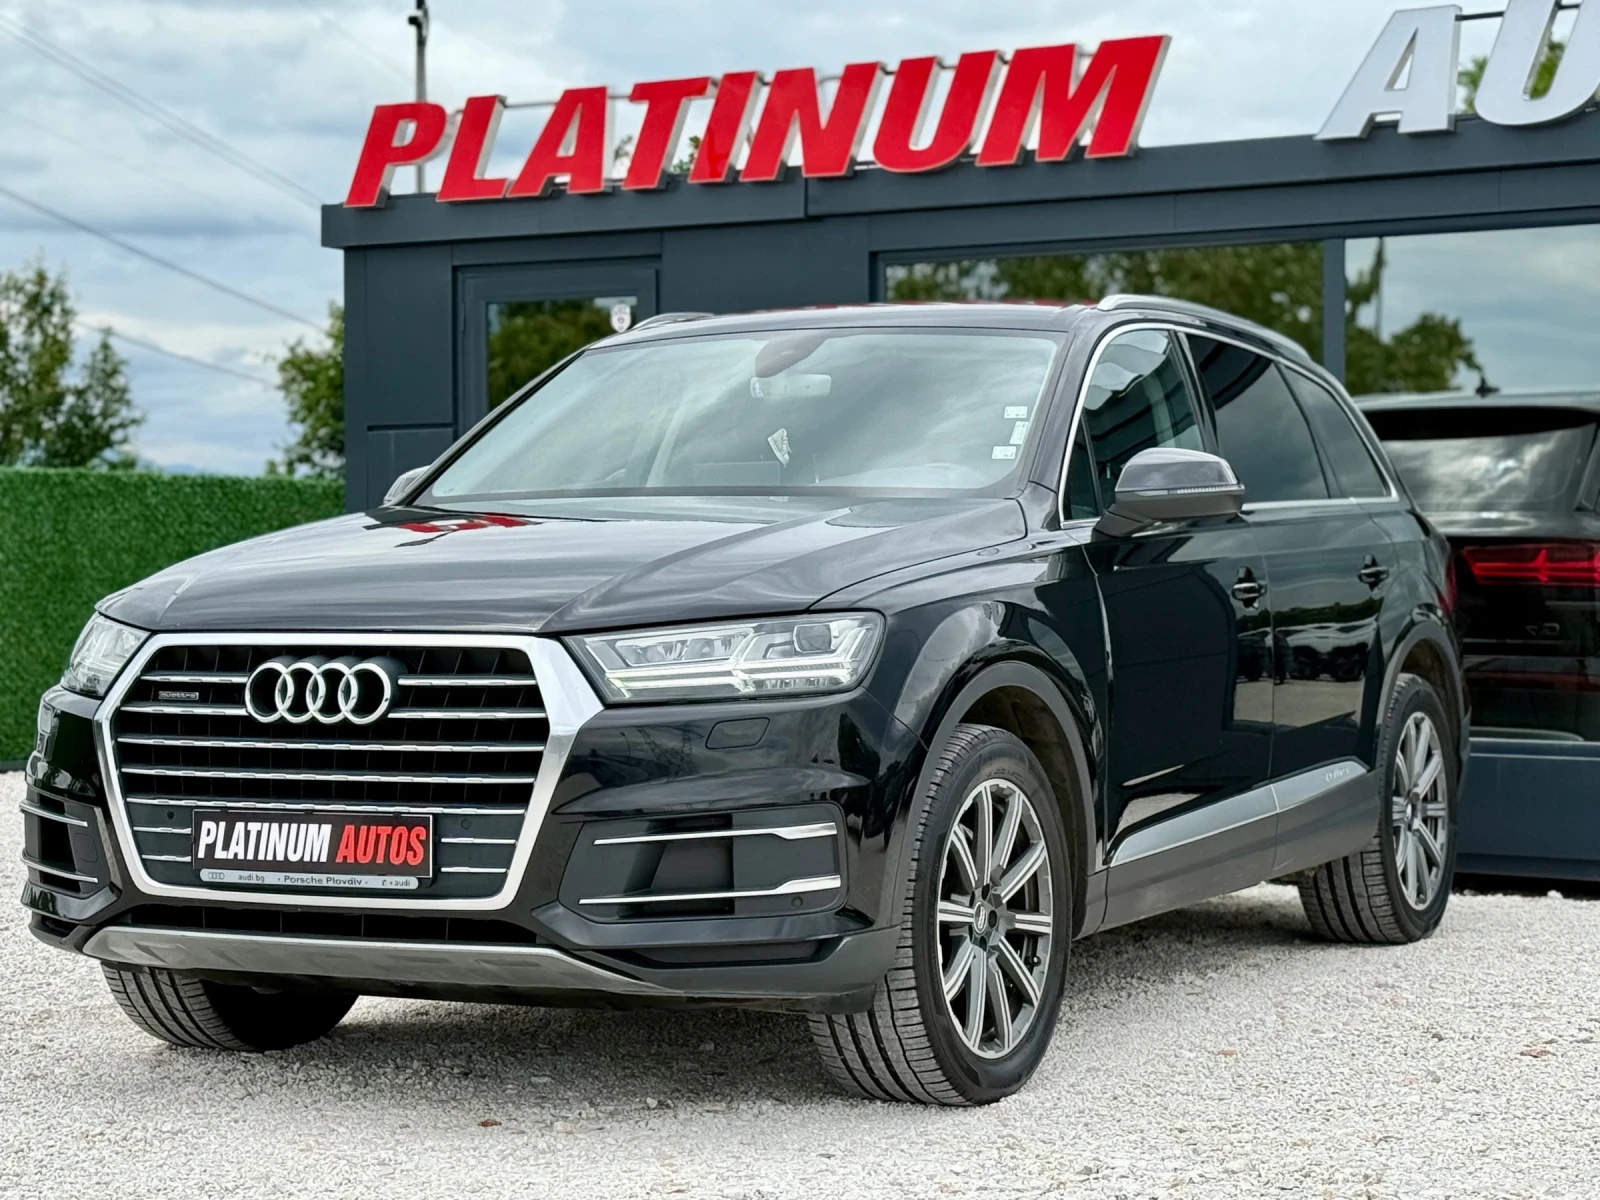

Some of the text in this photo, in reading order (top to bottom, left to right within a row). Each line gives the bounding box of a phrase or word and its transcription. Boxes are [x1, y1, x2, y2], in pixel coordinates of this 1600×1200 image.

[344, 35, 1171, 208] PLATINUM
[197, 820, 427, 866] PLATINUM AUTOS
[238, 873, 265, 884] audi.bg
[284, 875, 323, 885] Porsche
